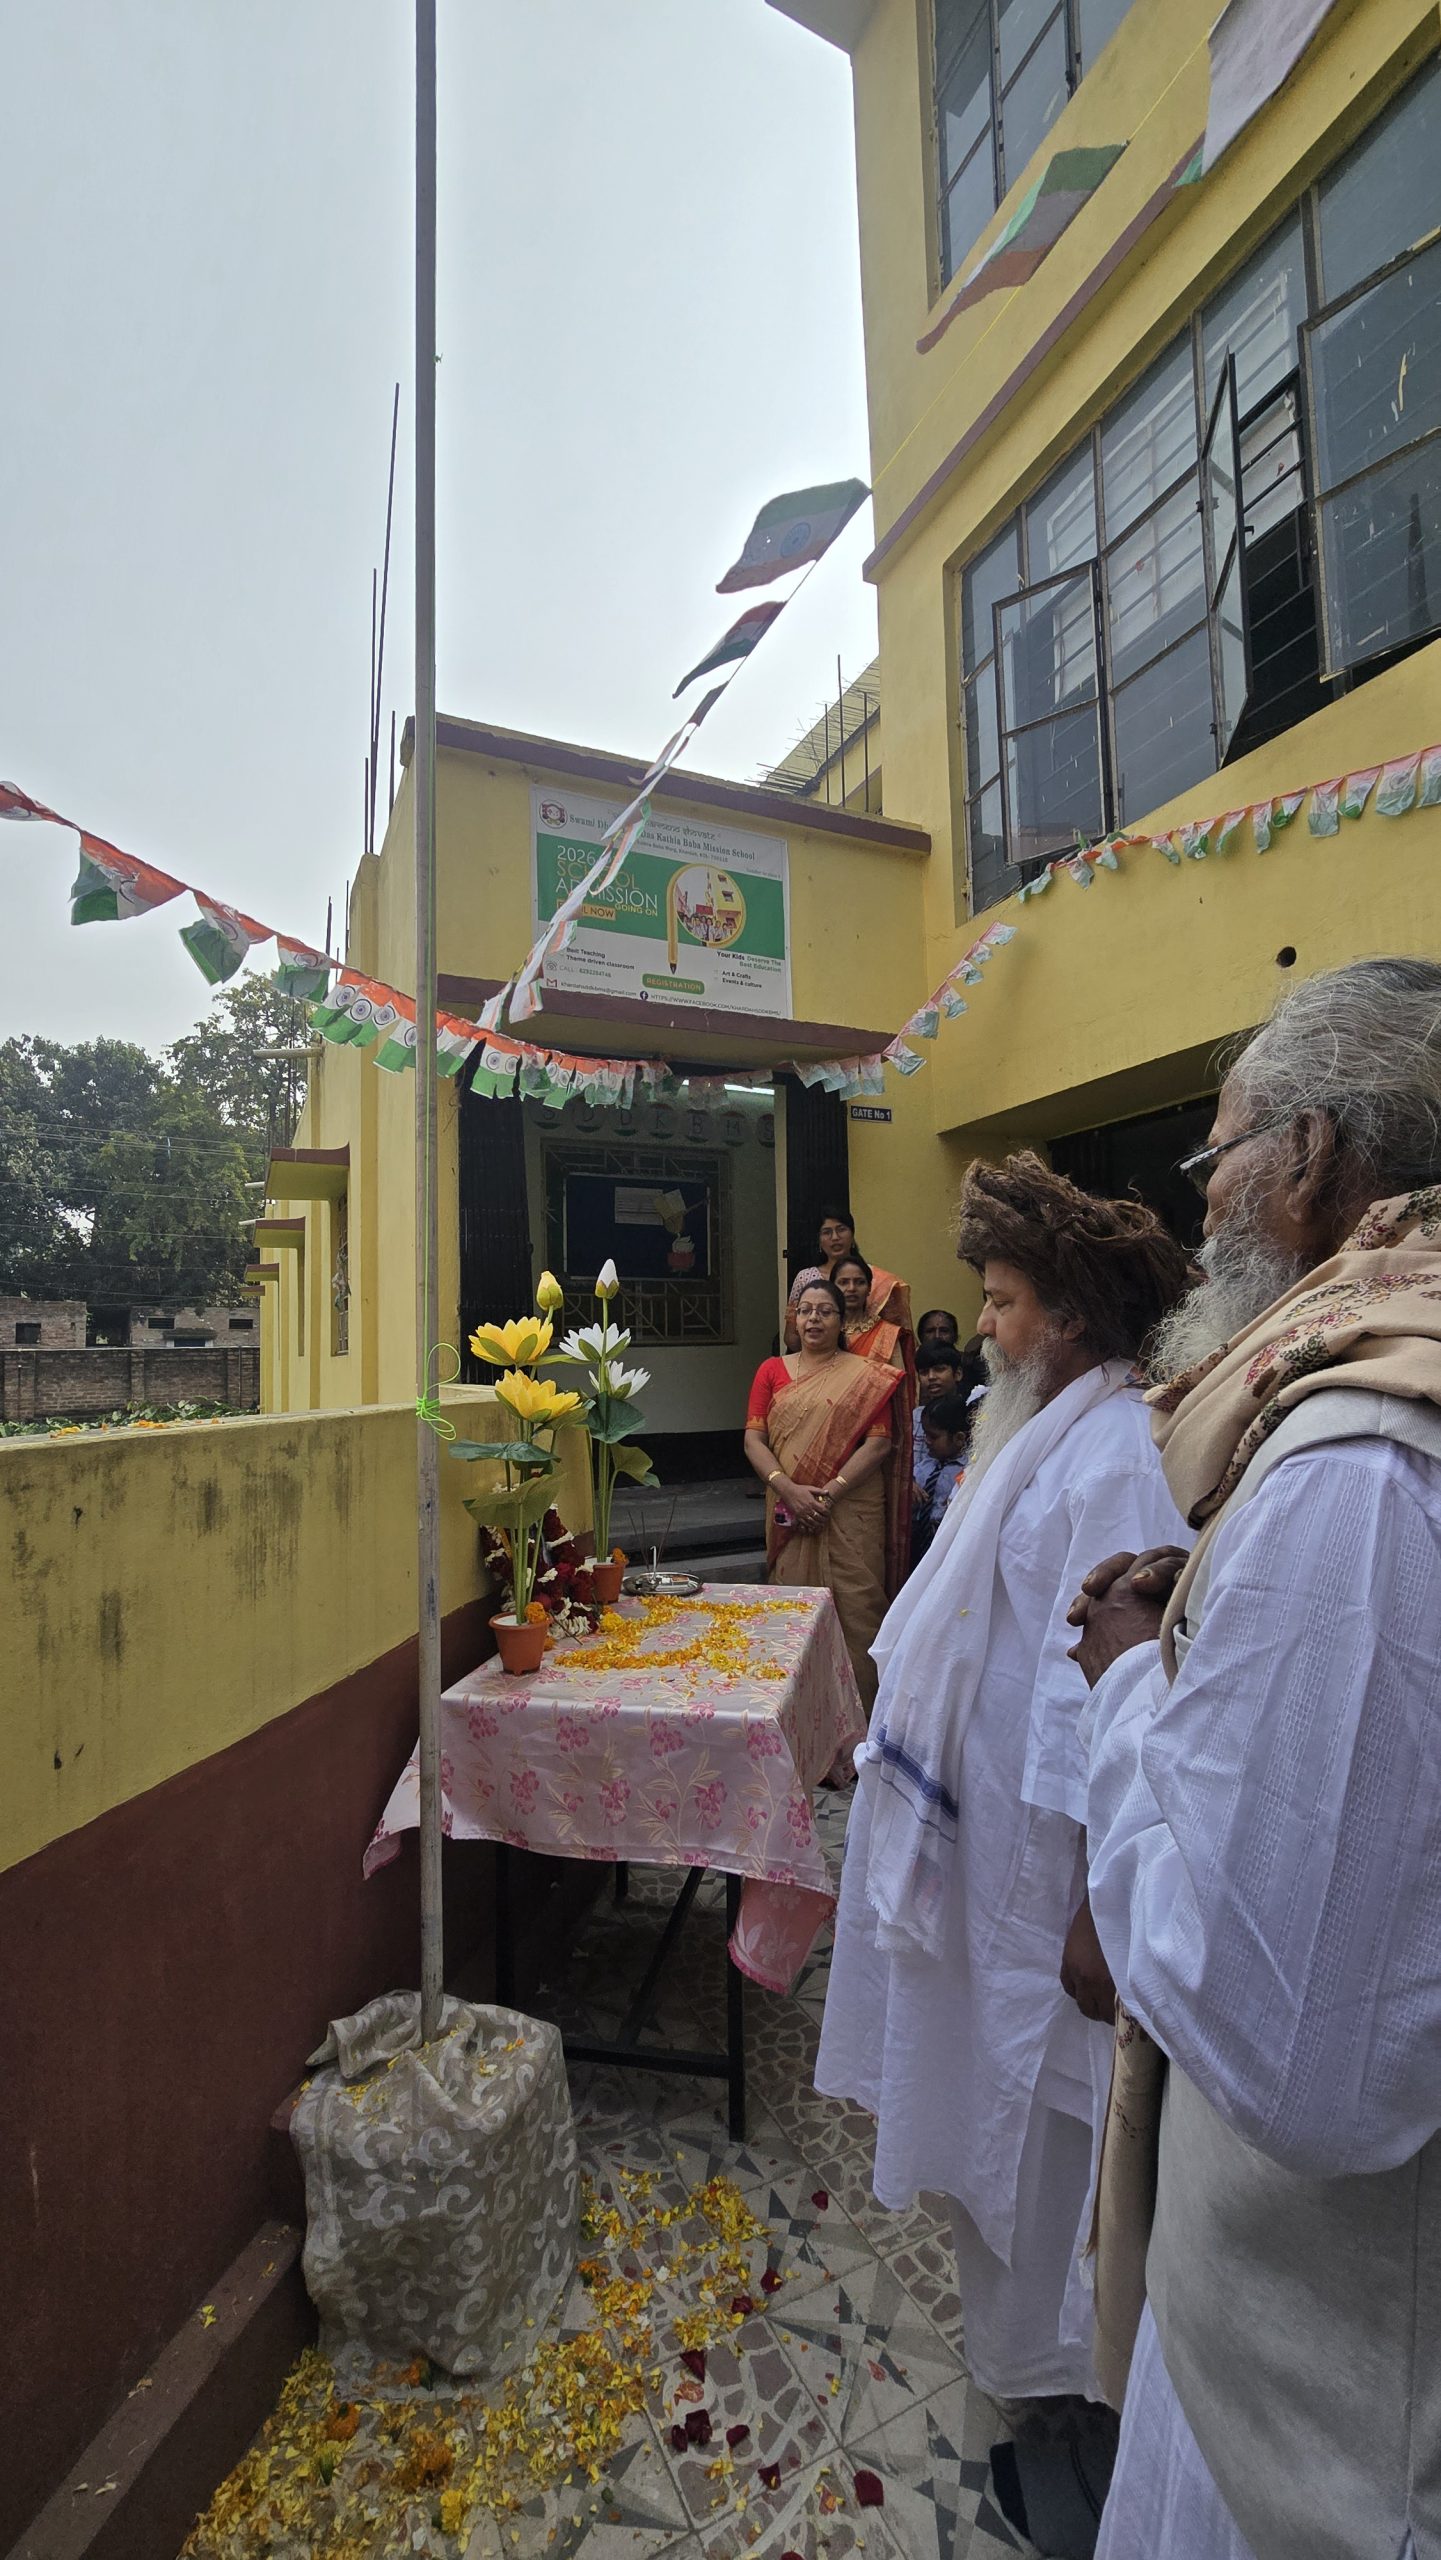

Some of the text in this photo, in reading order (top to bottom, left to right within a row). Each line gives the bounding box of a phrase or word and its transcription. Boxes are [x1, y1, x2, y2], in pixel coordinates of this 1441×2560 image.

[570, 814, 595, 827] Swami
[656, 833, 681, 845] Kathia
[683, 839, 701, 849] Baba
[703, 842, 731, 855] Mission
[732, 849, 755, 860] School
[557, 845, 595, 865] 2026
[557, 861, 639, 889] SCOL
[591, 907, 615, 918] NOW
[614, 903, 658, 917] GOING ON
[581, 949, 605, 959] Teaching
[747, 956, 770, 964] Deserve
[587, 958, 605, 966] driven
[606, 961, 635, 970] classroom
[754, 964, 781, 972] Education
[646, 977, 701, 992] REGISTRATION
[852, 1107, 890, 1120] GATE No 1
